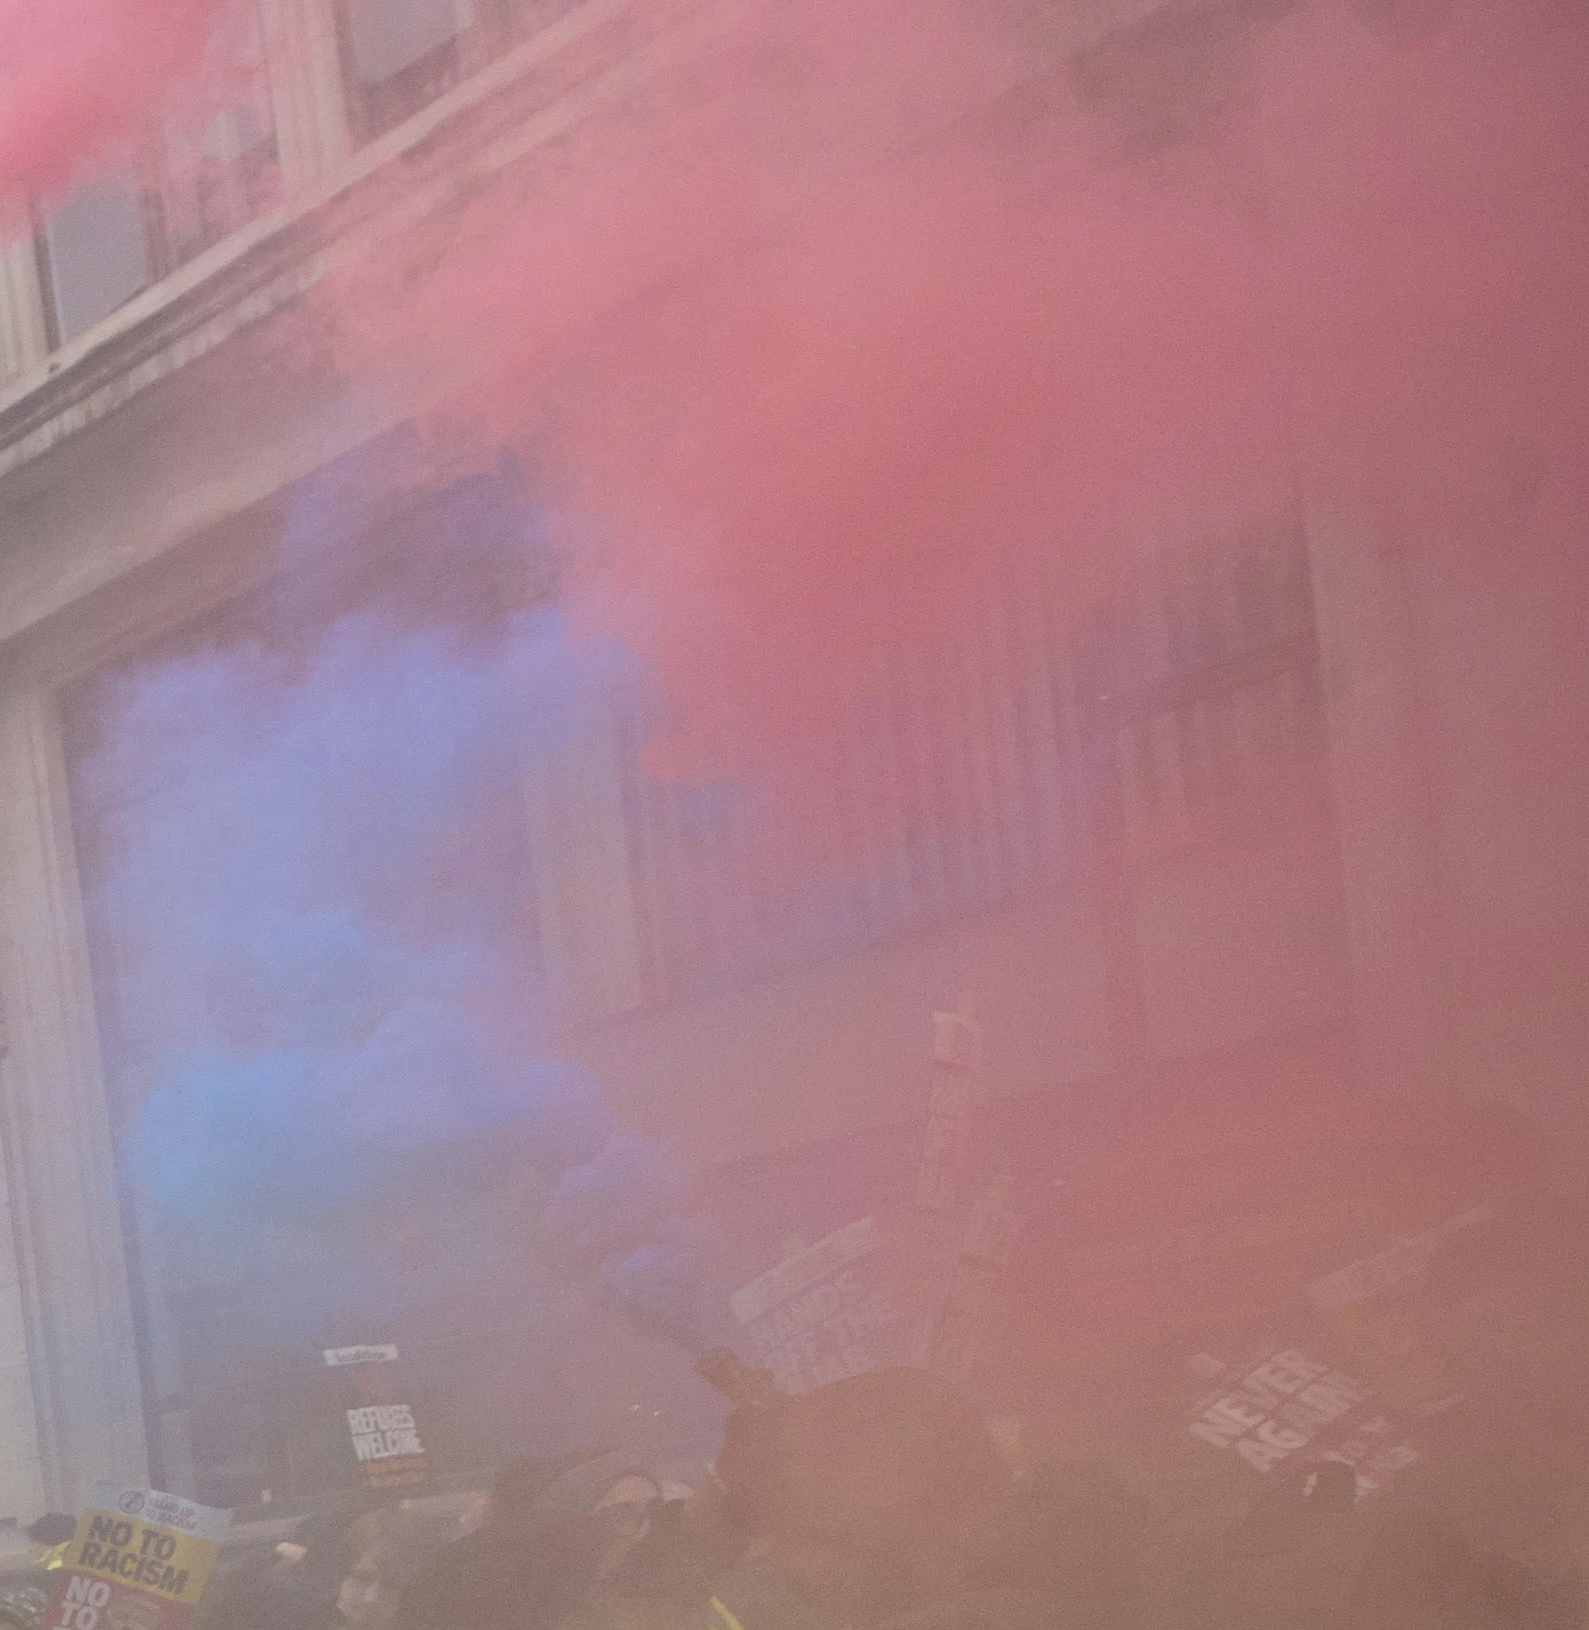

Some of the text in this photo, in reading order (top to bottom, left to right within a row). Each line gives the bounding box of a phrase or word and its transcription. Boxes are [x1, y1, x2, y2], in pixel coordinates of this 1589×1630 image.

[1188, 1349, 1328, 1449] NEVER
[89, 1516, 177, 1560] NO TO
[79, 1542, 190, 1595] RACISM
[65, 1575, 111, 1608] NO
[60, 1602, 98, 1630] TO
